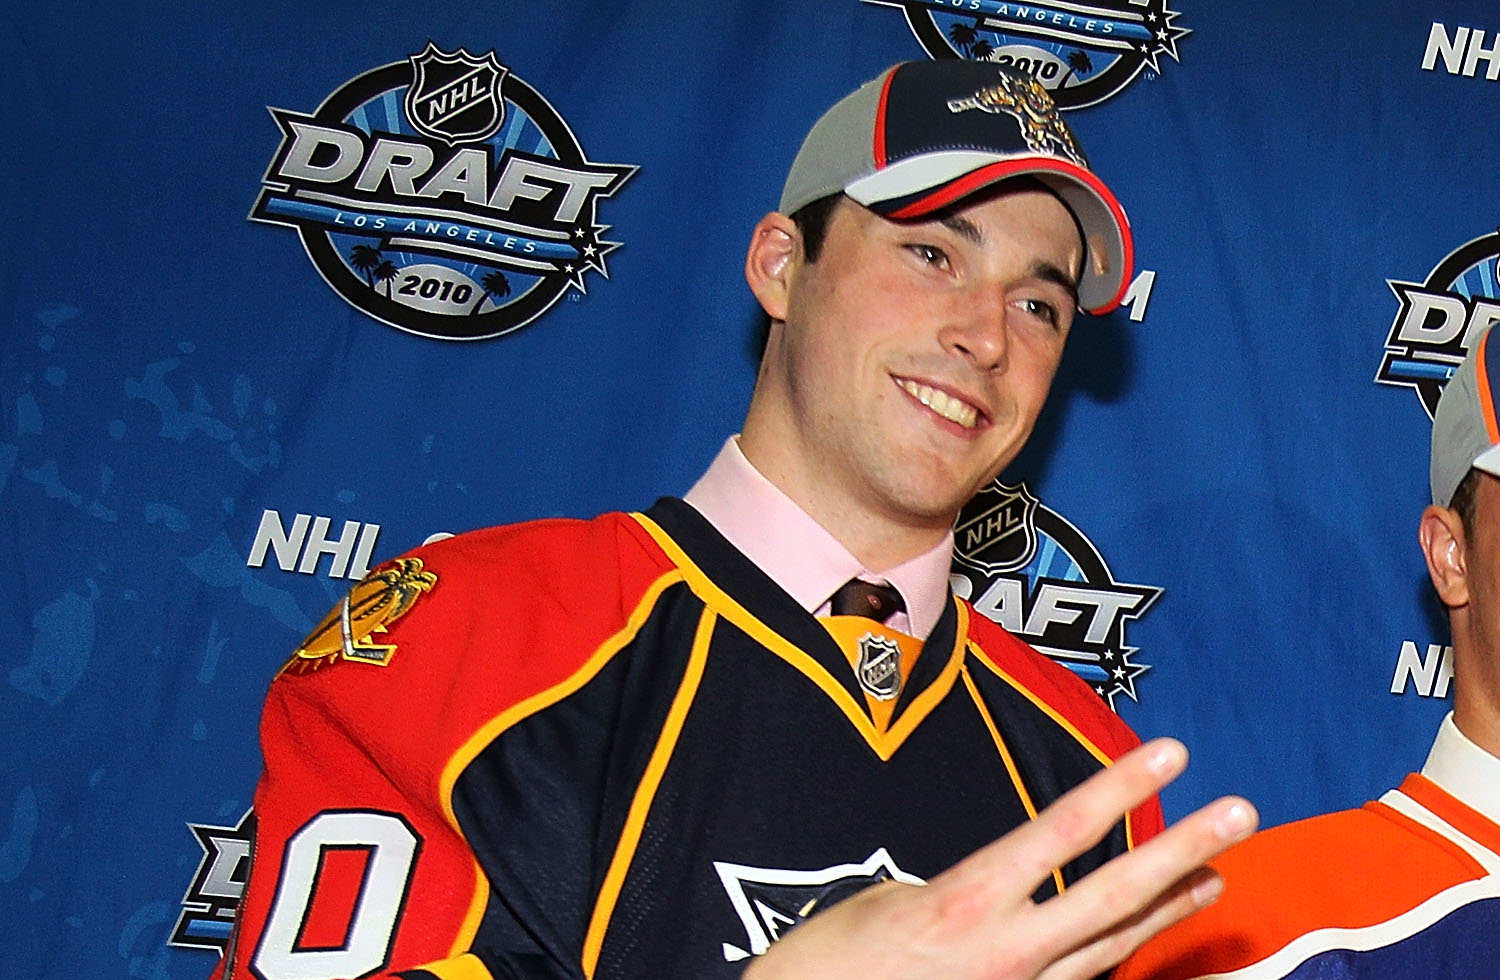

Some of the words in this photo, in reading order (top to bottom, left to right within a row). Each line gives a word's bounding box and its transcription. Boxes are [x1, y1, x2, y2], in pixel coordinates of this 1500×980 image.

[934, 0, 981, 10] OS
[997, 5, 1114, 33] ANGELES
[427, 76, 487, 121] NHL
[278, 122, 618, 223] DRAFT
[334, 212, 387, 230] LOS
[404, 219, 537, 253] ANGELES
[398, 275, 473, 305] 2010
[966, 506, 1018, 549] NHL
[951, 573, 1144, 643] AFT
